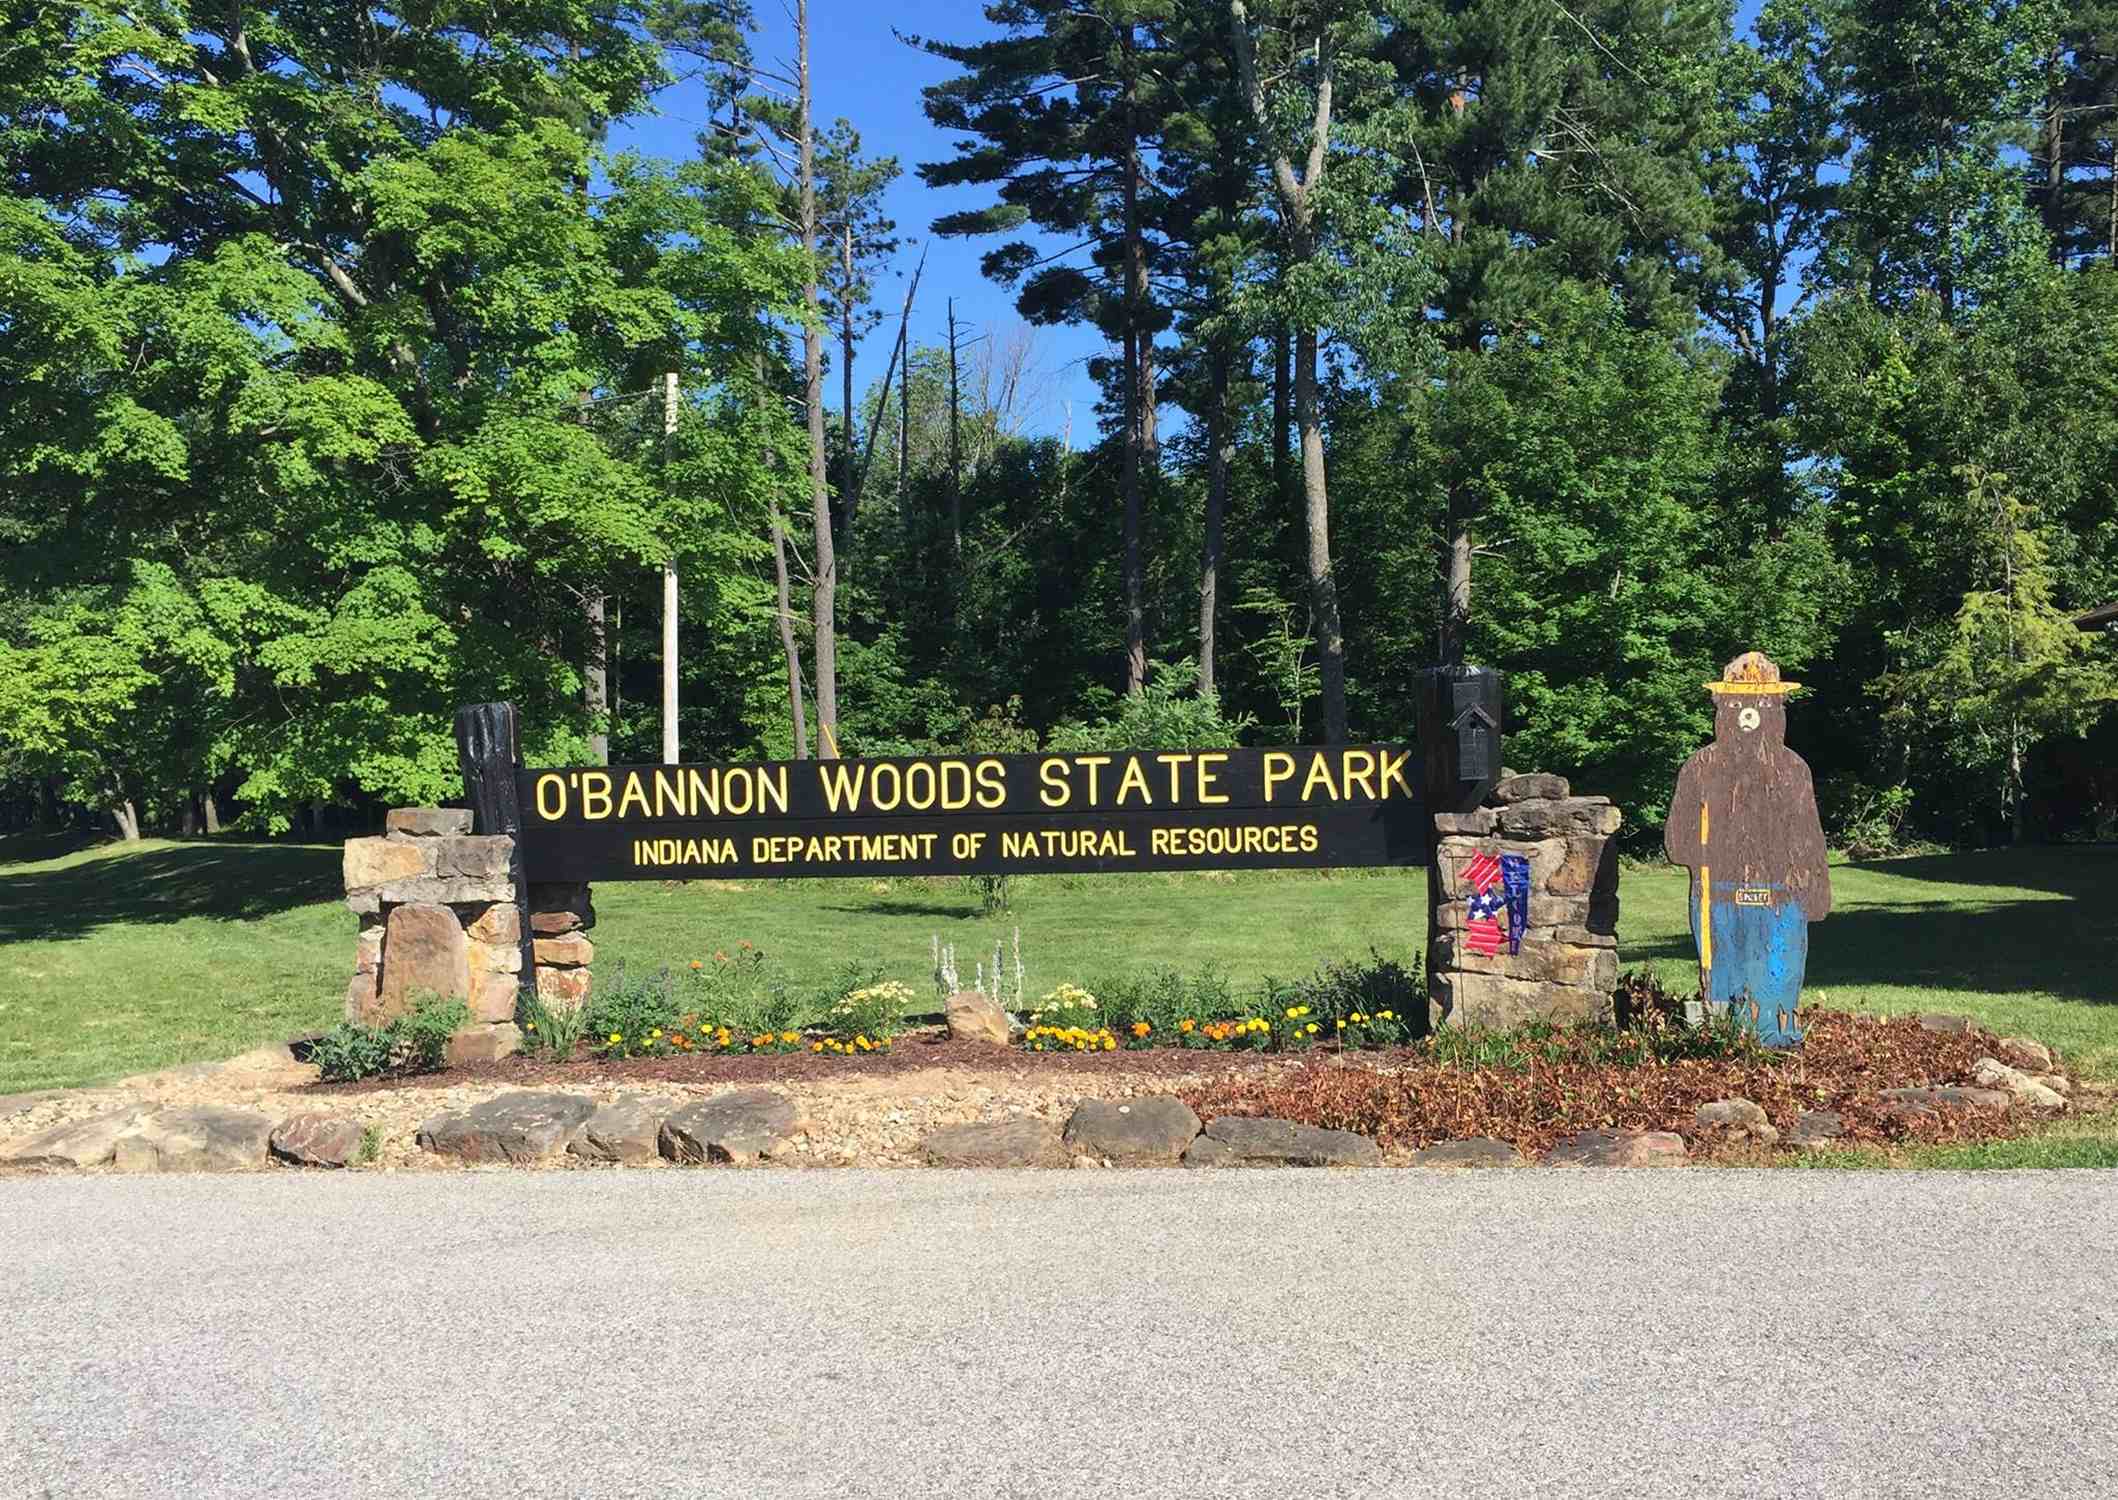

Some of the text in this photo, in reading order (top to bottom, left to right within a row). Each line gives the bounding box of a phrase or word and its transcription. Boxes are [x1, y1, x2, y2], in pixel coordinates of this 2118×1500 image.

[536, 749, 1413, 820] O'BANNON WOODS STATE PARK
[634, 825, 1318, 865] INDIANA DEPARTMENT OF NATURAL RESOURCES
